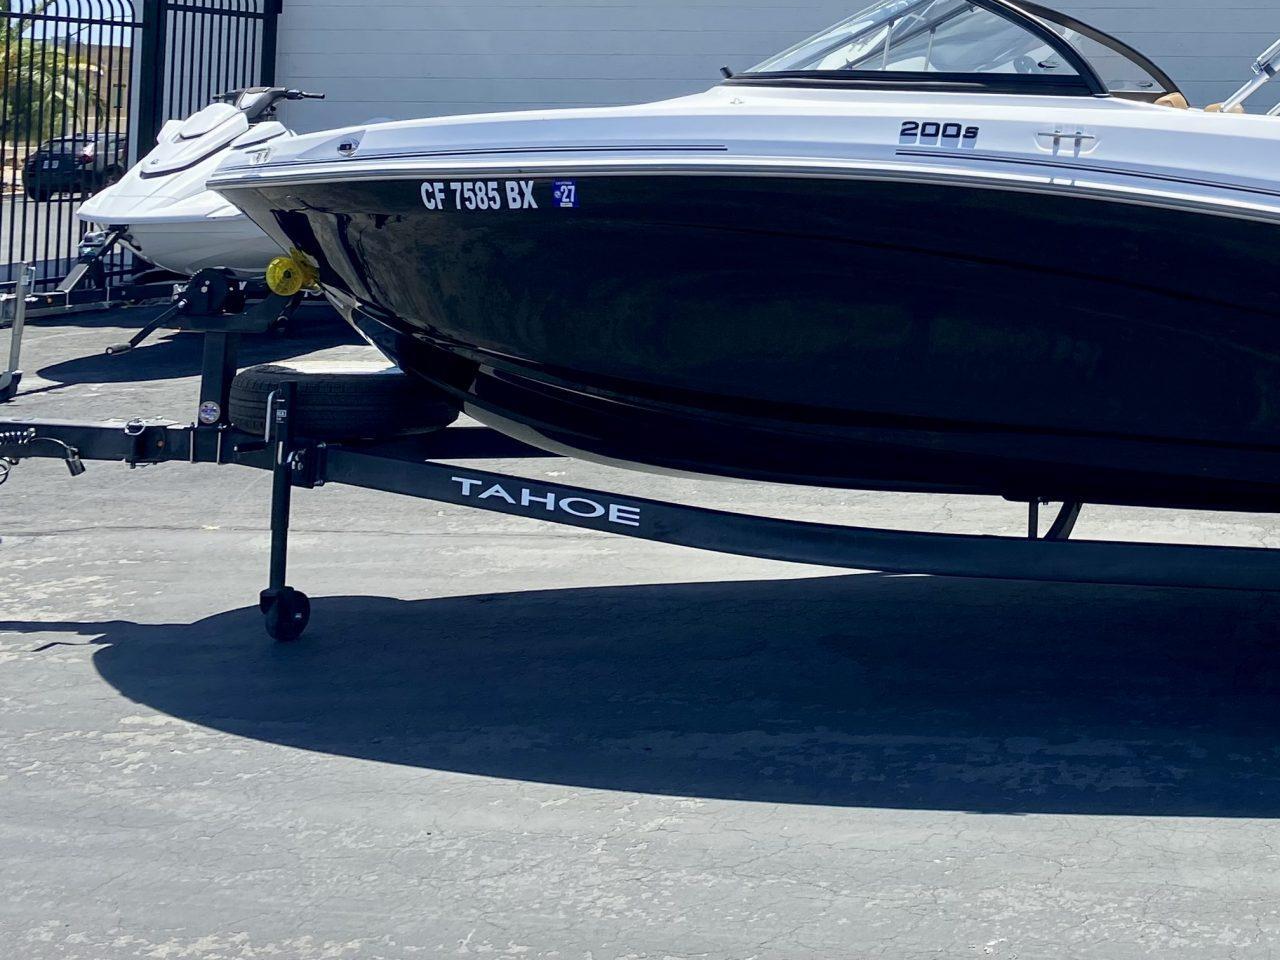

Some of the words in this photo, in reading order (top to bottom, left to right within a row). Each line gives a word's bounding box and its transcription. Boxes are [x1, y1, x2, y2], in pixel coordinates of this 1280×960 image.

[420, 181, 446, 210] CF
[450, 181, 501, 210] 7585
[505, 180, 539, 209] BX
[560, 185, 575, 203] 27
[451, 476, 641, 527] TAHOE
